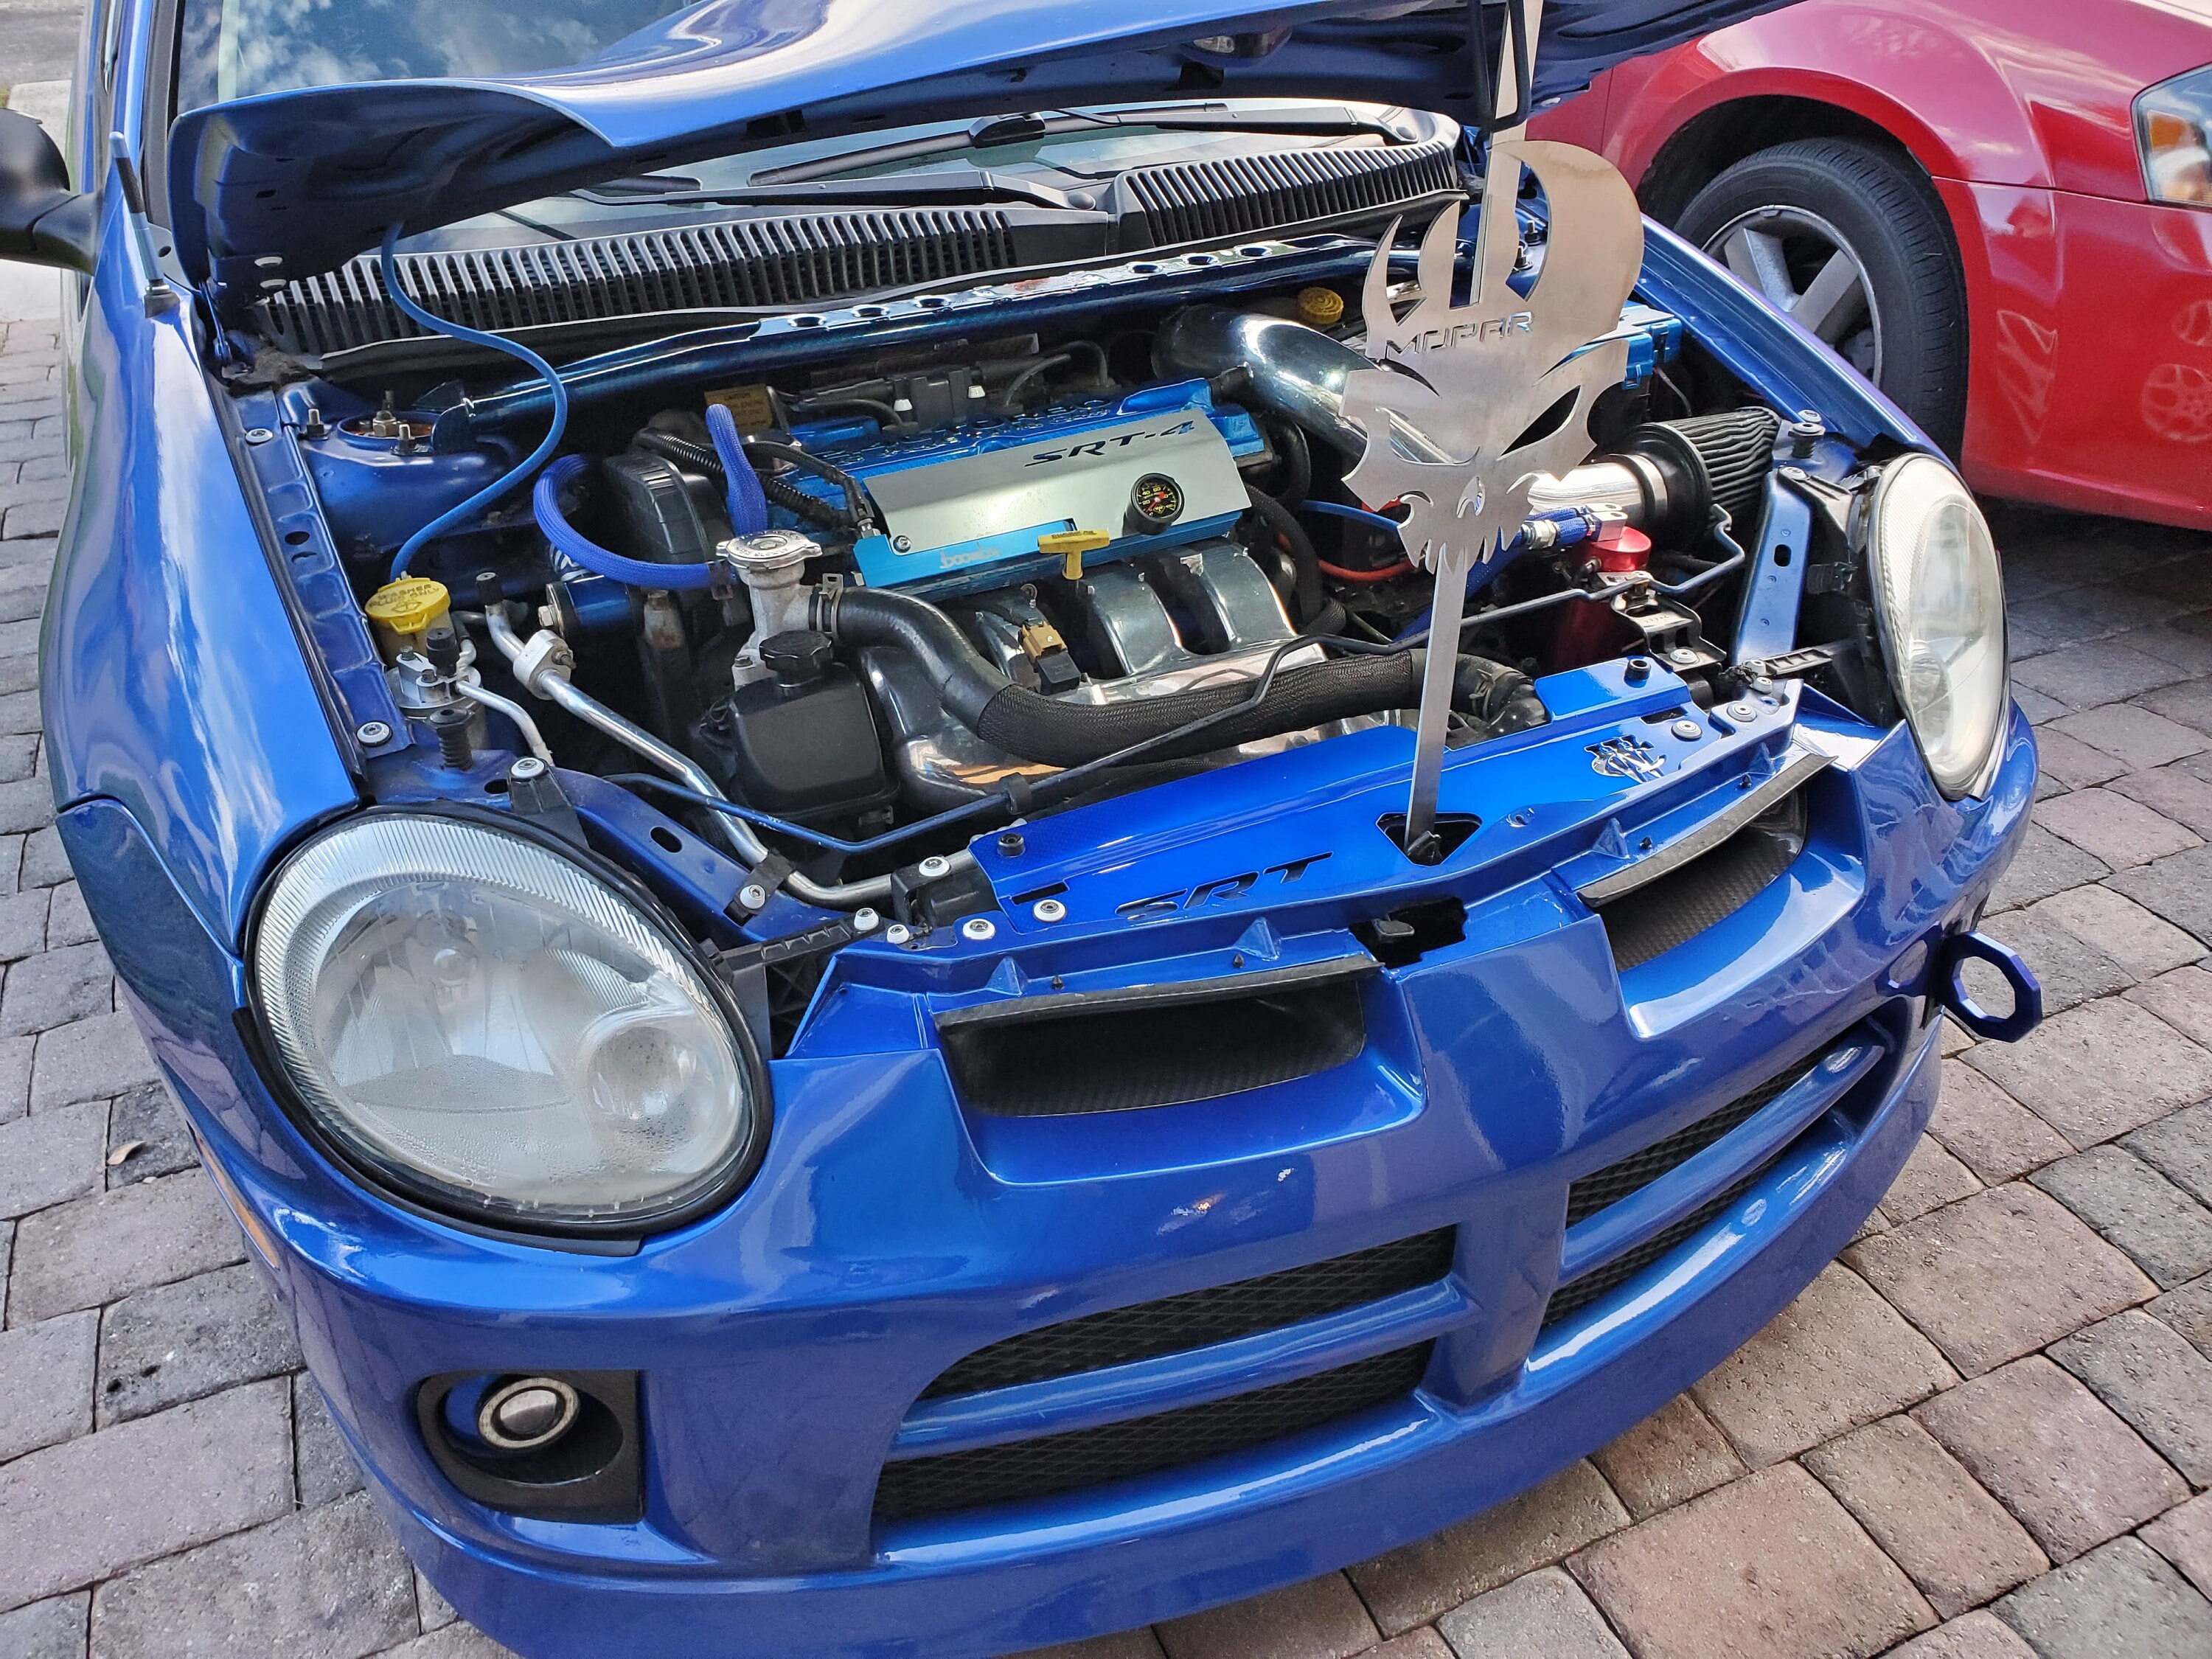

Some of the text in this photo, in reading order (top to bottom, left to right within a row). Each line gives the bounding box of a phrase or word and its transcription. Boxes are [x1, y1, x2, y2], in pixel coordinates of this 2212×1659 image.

[1385, 310, 1533, 360] MOPAR
[1024, 420, 1194, 467] SRT-4
[378, 584, 431, 599] WASHER
[1114, 851, 1334, 921] SRT
